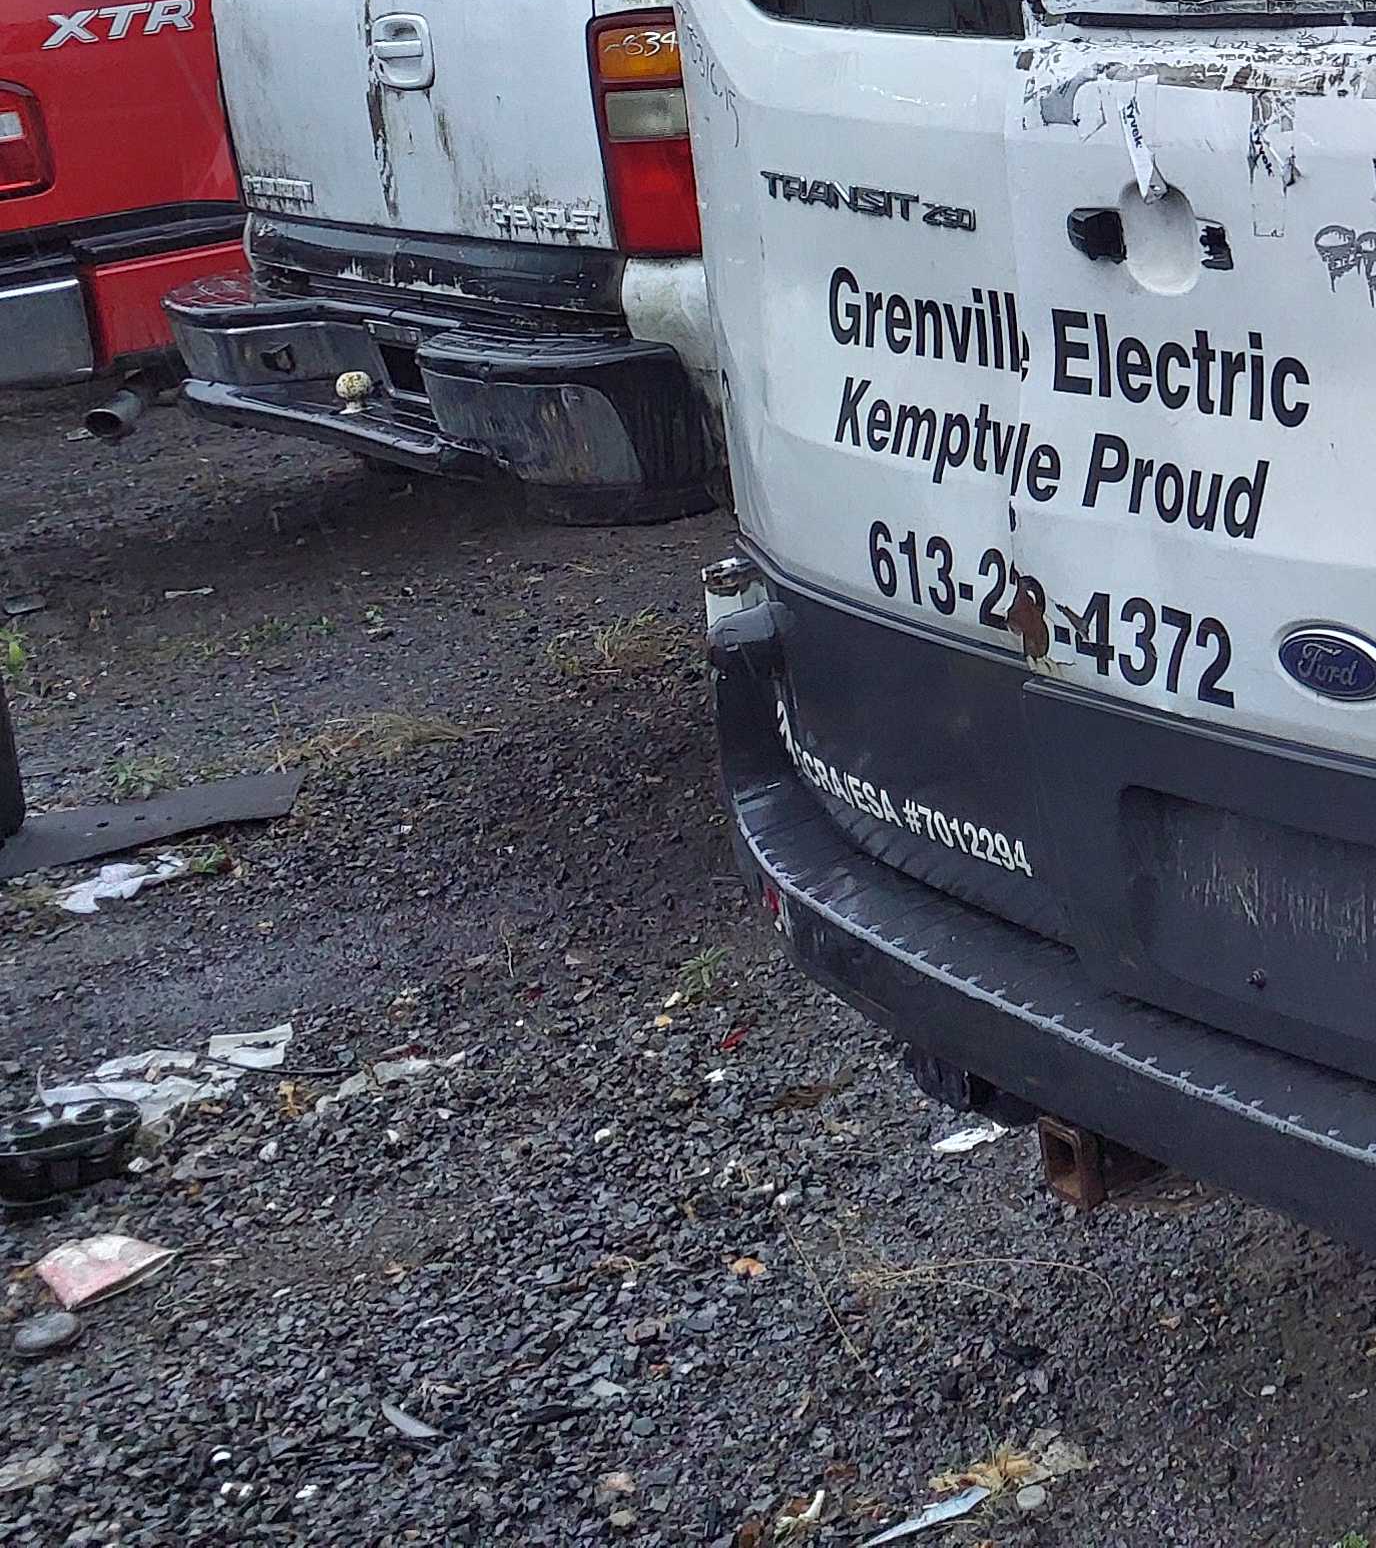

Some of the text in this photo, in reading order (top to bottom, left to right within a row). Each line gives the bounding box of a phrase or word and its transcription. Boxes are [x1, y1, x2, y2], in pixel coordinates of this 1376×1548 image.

[1126, 100, 1143, 149] Tyvek
[760, 170, 920, 221] TRANSIT
[1052, 308, 1310, 428] Electric
[1082, 433, 1269, 539] Proud
[1296, 640, 1357, 686] Ford
[903, 798, 1033, 878] #7012294
